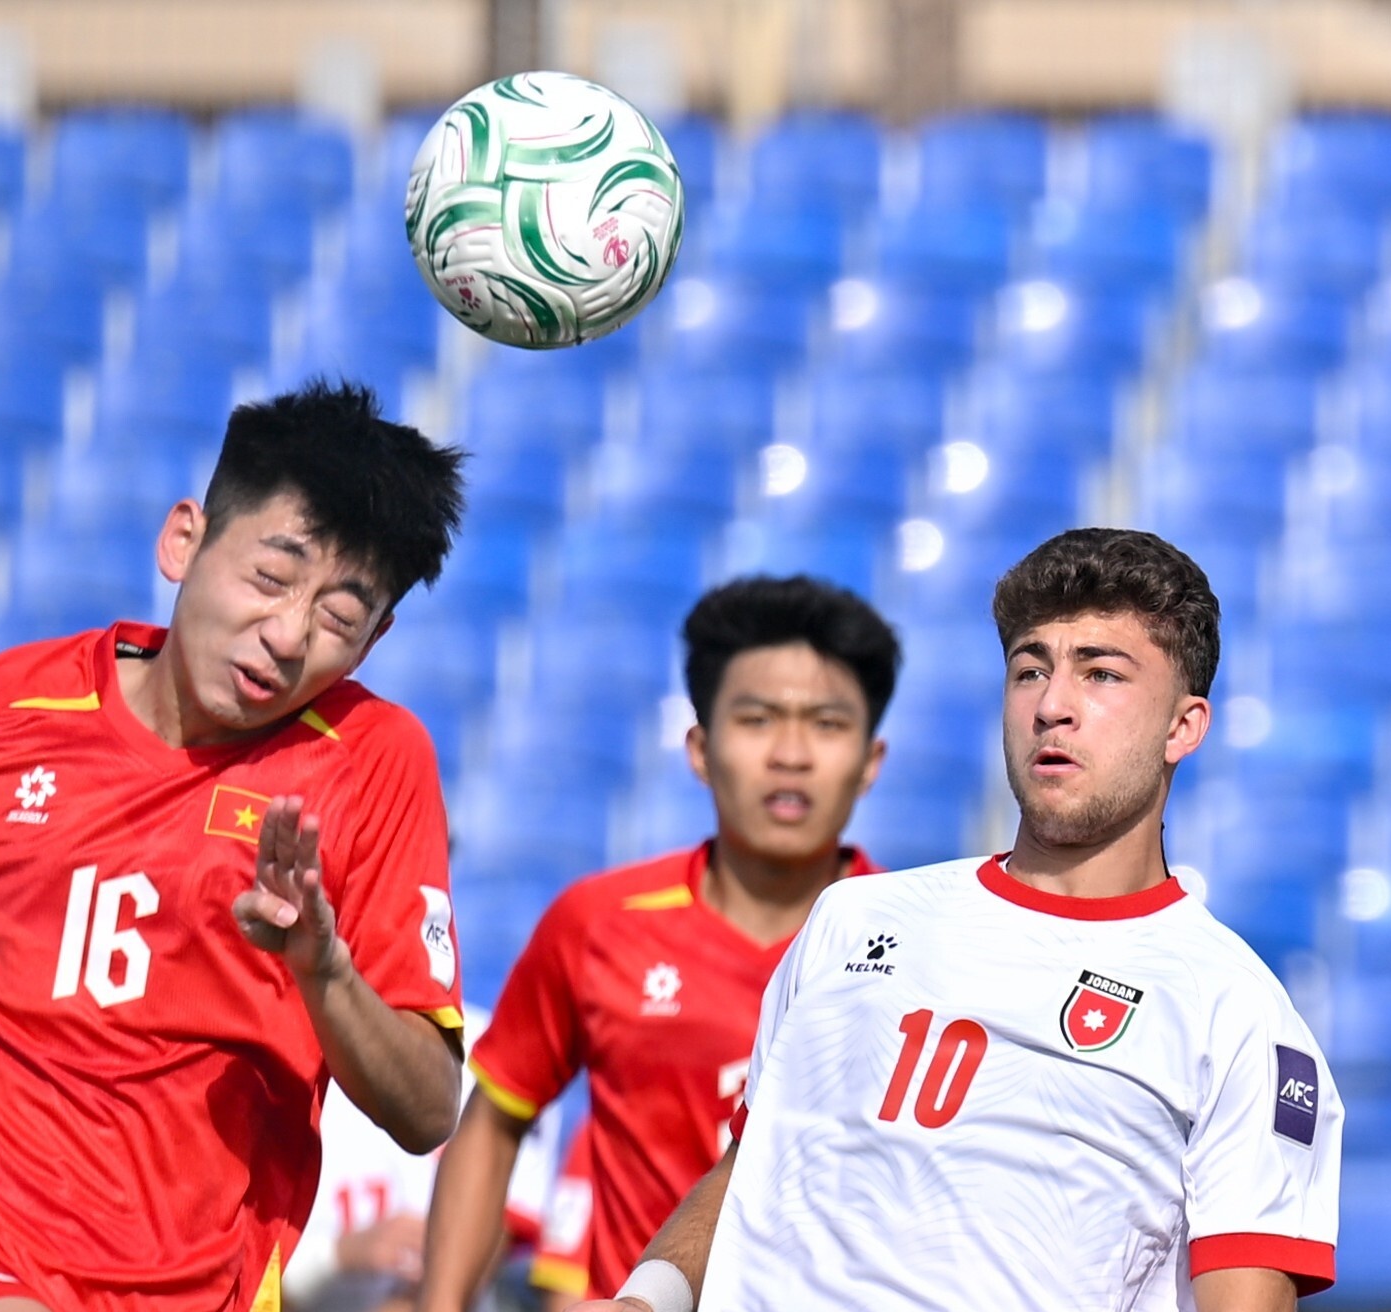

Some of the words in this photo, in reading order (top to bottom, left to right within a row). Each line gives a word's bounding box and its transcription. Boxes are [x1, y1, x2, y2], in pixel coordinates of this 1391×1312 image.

[52, 865, 159, 1009] 16
[845, 962, 895, 976] KELME
[1086, 974, 1136, 1001] JORDAN
[878, 1008, 988, 1129] 10
[1279, 1077, 1314, 1108] AFC
